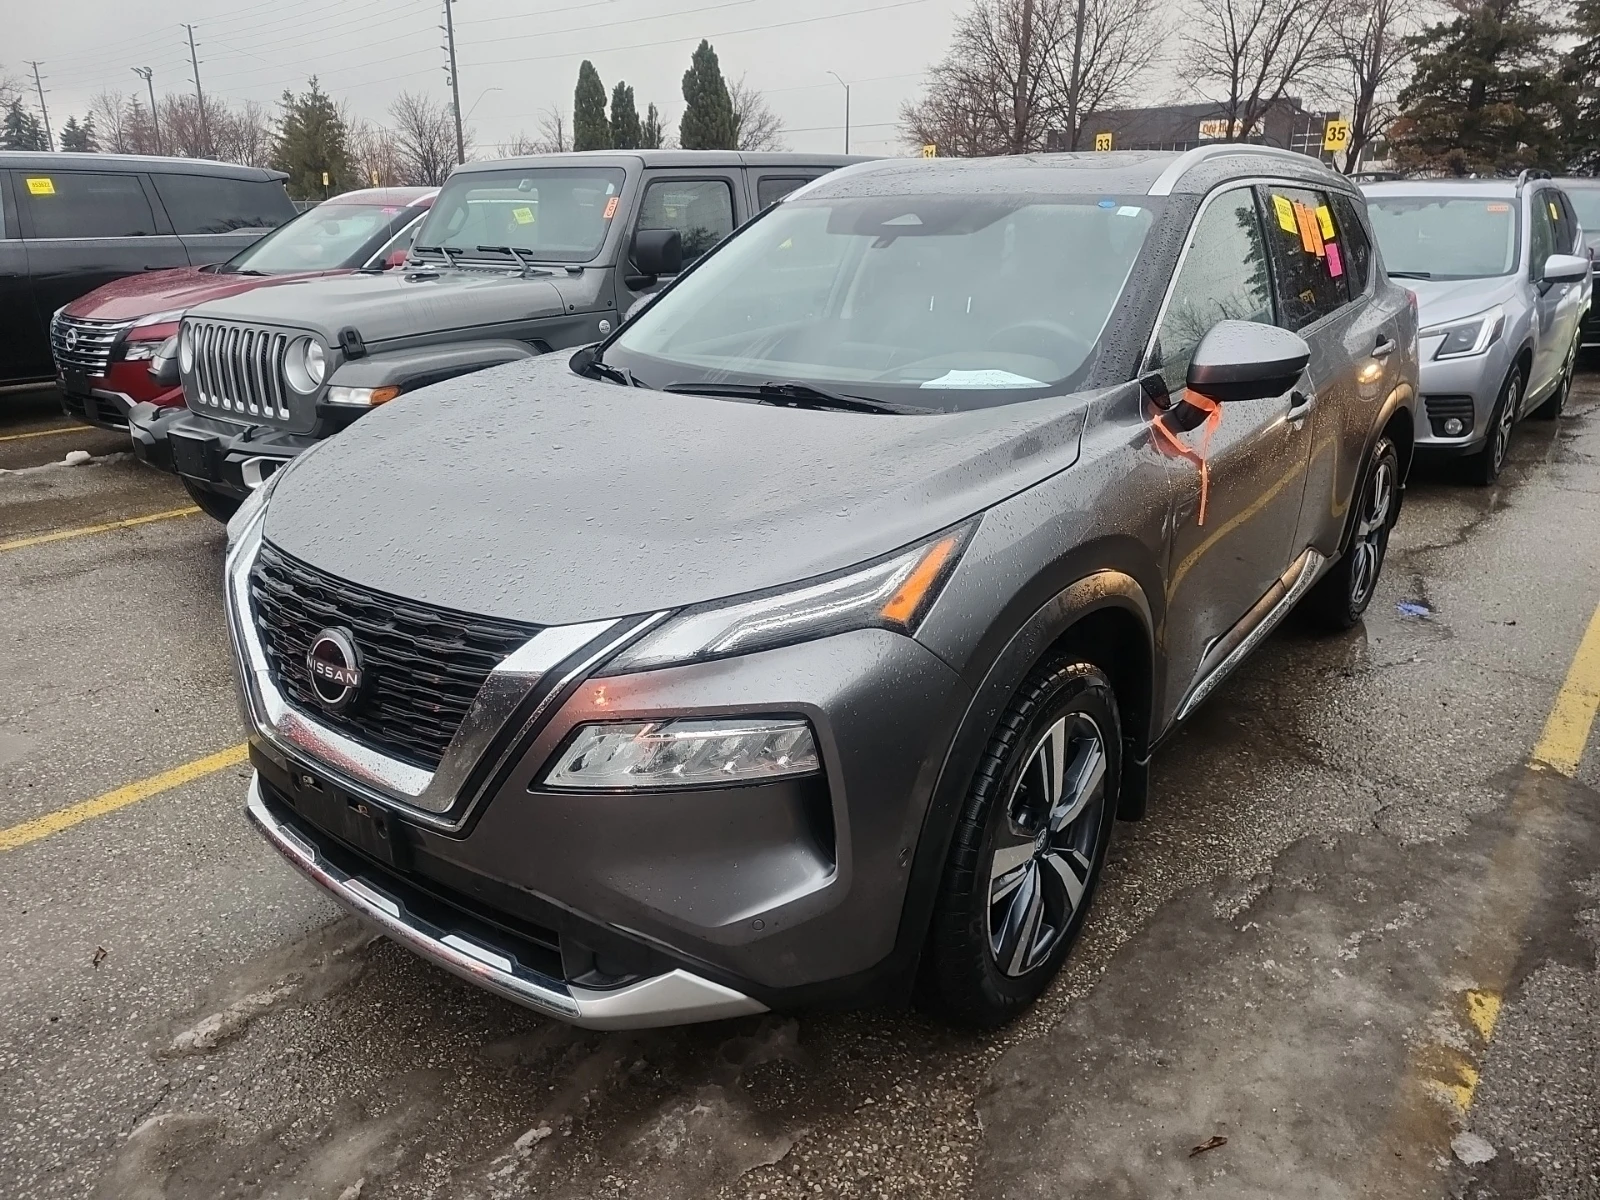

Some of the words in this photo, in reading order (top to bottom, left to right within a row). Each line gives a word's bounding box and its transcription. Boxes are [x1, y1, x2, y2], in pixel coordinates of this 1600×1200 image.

[1327, 127, 1346, 142] 35
[1097, 138, 1110, 151] 33
[306, 655, 358, 686] NISSAN
